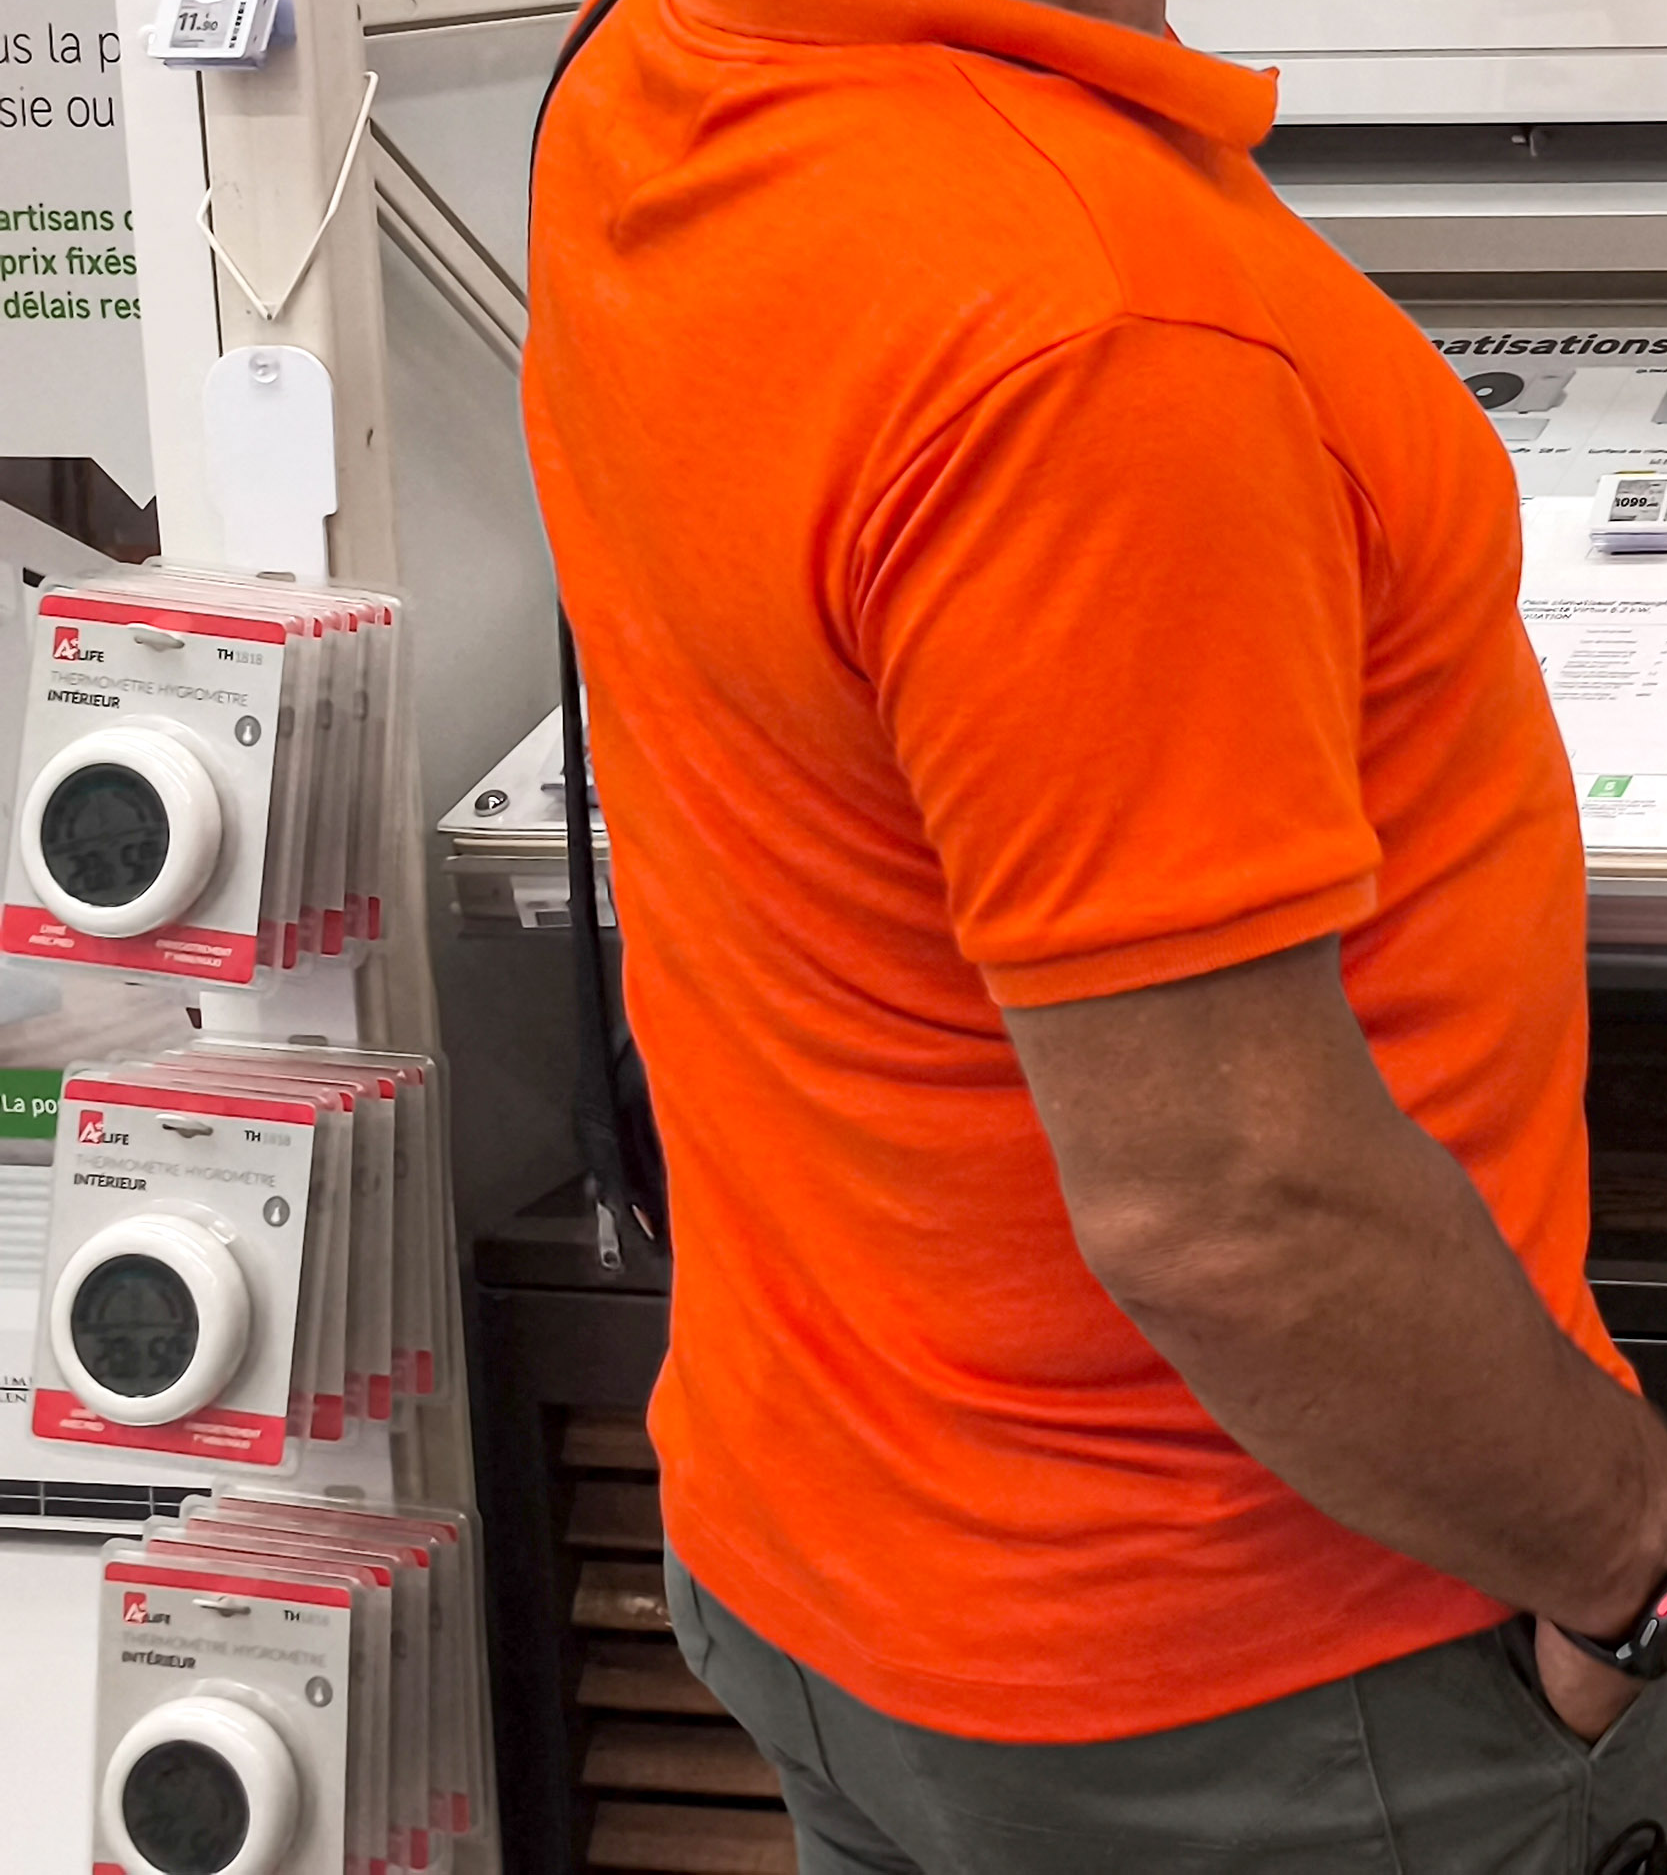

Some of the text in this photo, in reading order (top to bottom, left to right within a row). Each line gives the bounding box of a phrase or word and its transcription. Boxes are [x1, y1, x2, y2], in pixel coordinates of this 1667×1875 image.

[48, 22, 82, 64] la
[67, 96, 115, 127] ou
[0, 247, 57, 282] prix
[4, 291, 91, 319] délais
[217, 649, 234, 661] TH
[48, 689, 120, 709] INTÉRIEUR
[1, 1094, 25, 1112] La
[244, 1130, 261, 1142] TH
[74, 1173, 146, 1191] INTÉRIEUR
